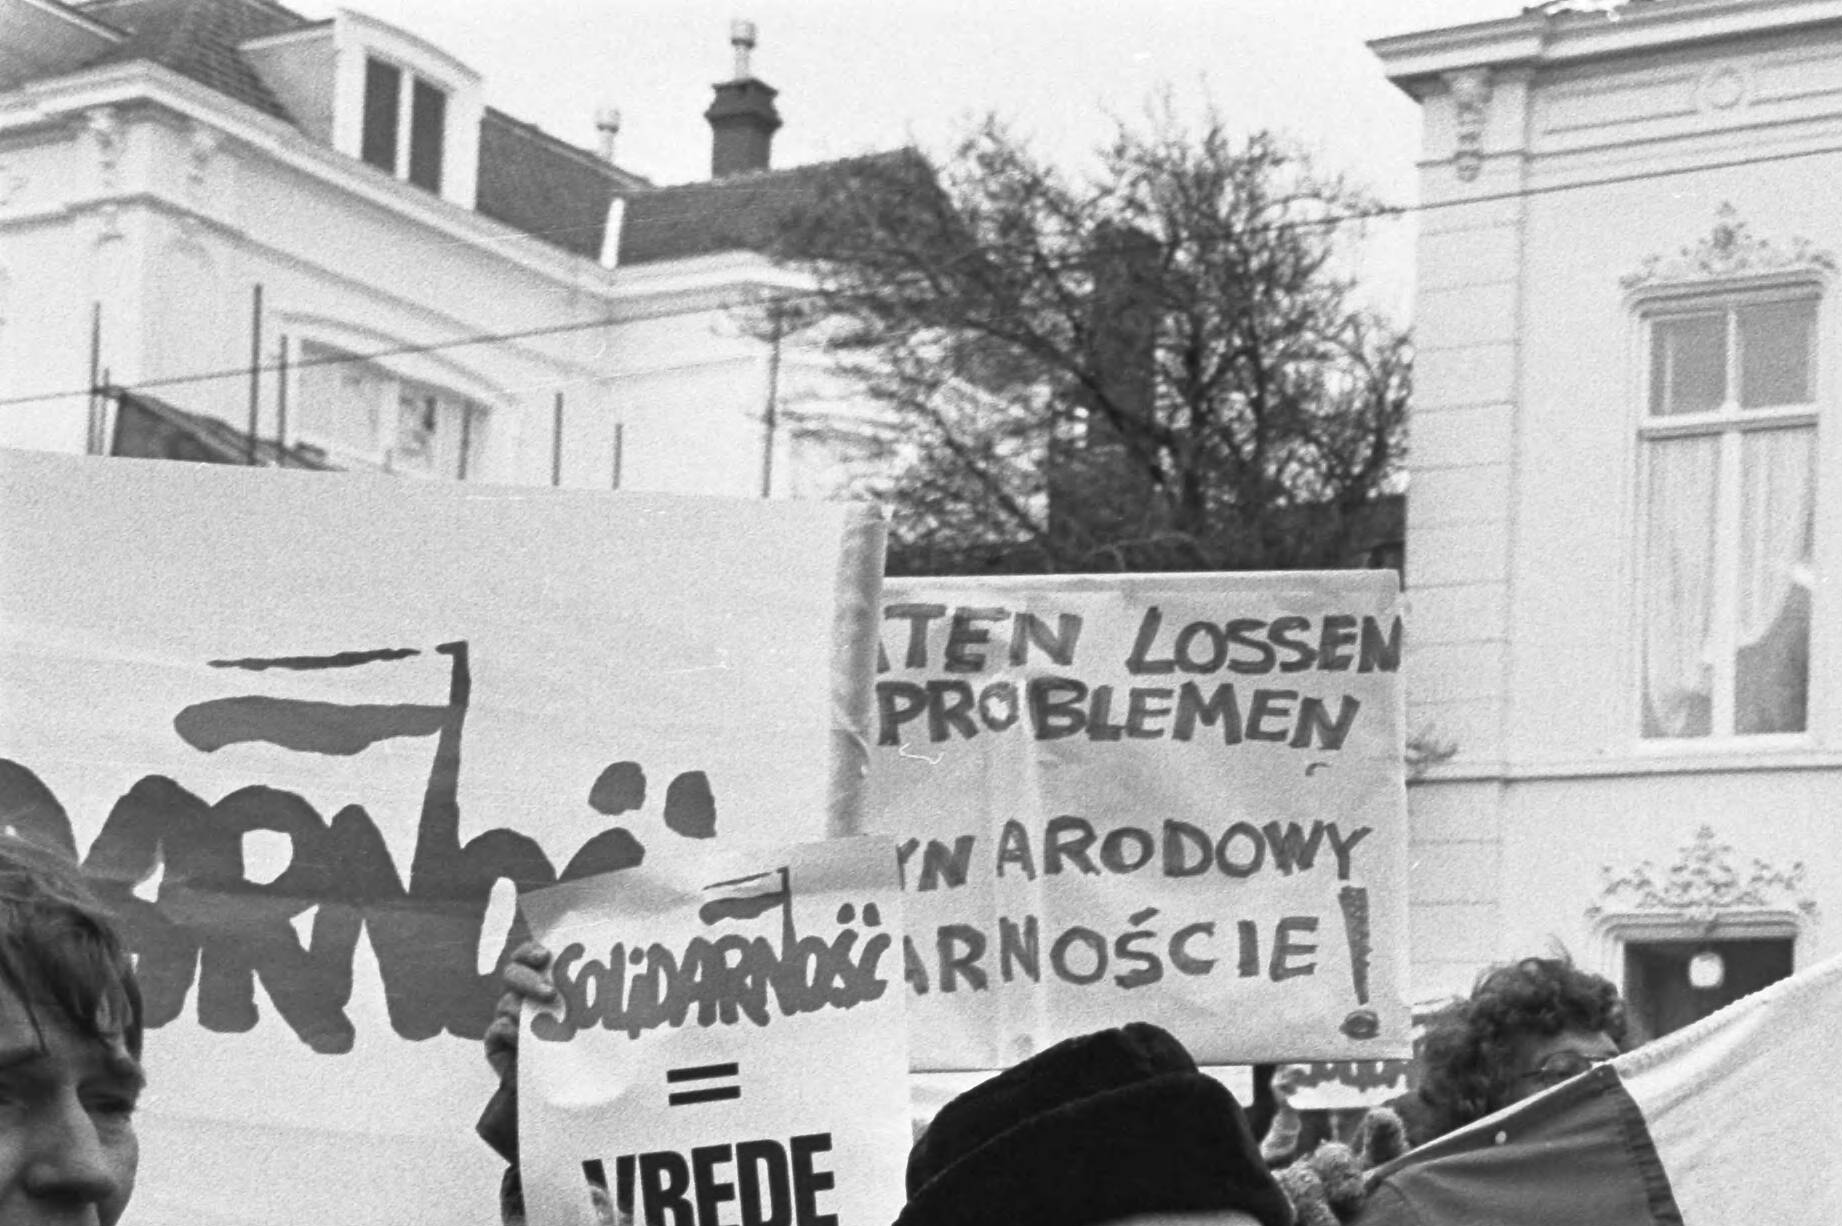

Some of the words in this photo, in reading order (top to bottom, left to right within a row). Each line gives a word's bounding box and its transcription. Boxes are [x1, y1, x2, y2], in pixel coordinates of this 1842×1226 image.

[877, 603, 1083, 674] TEN
[1126, 606, 1401, 675] LOSSEN
[875, 677, 1360, 750] PROBLEMEN
